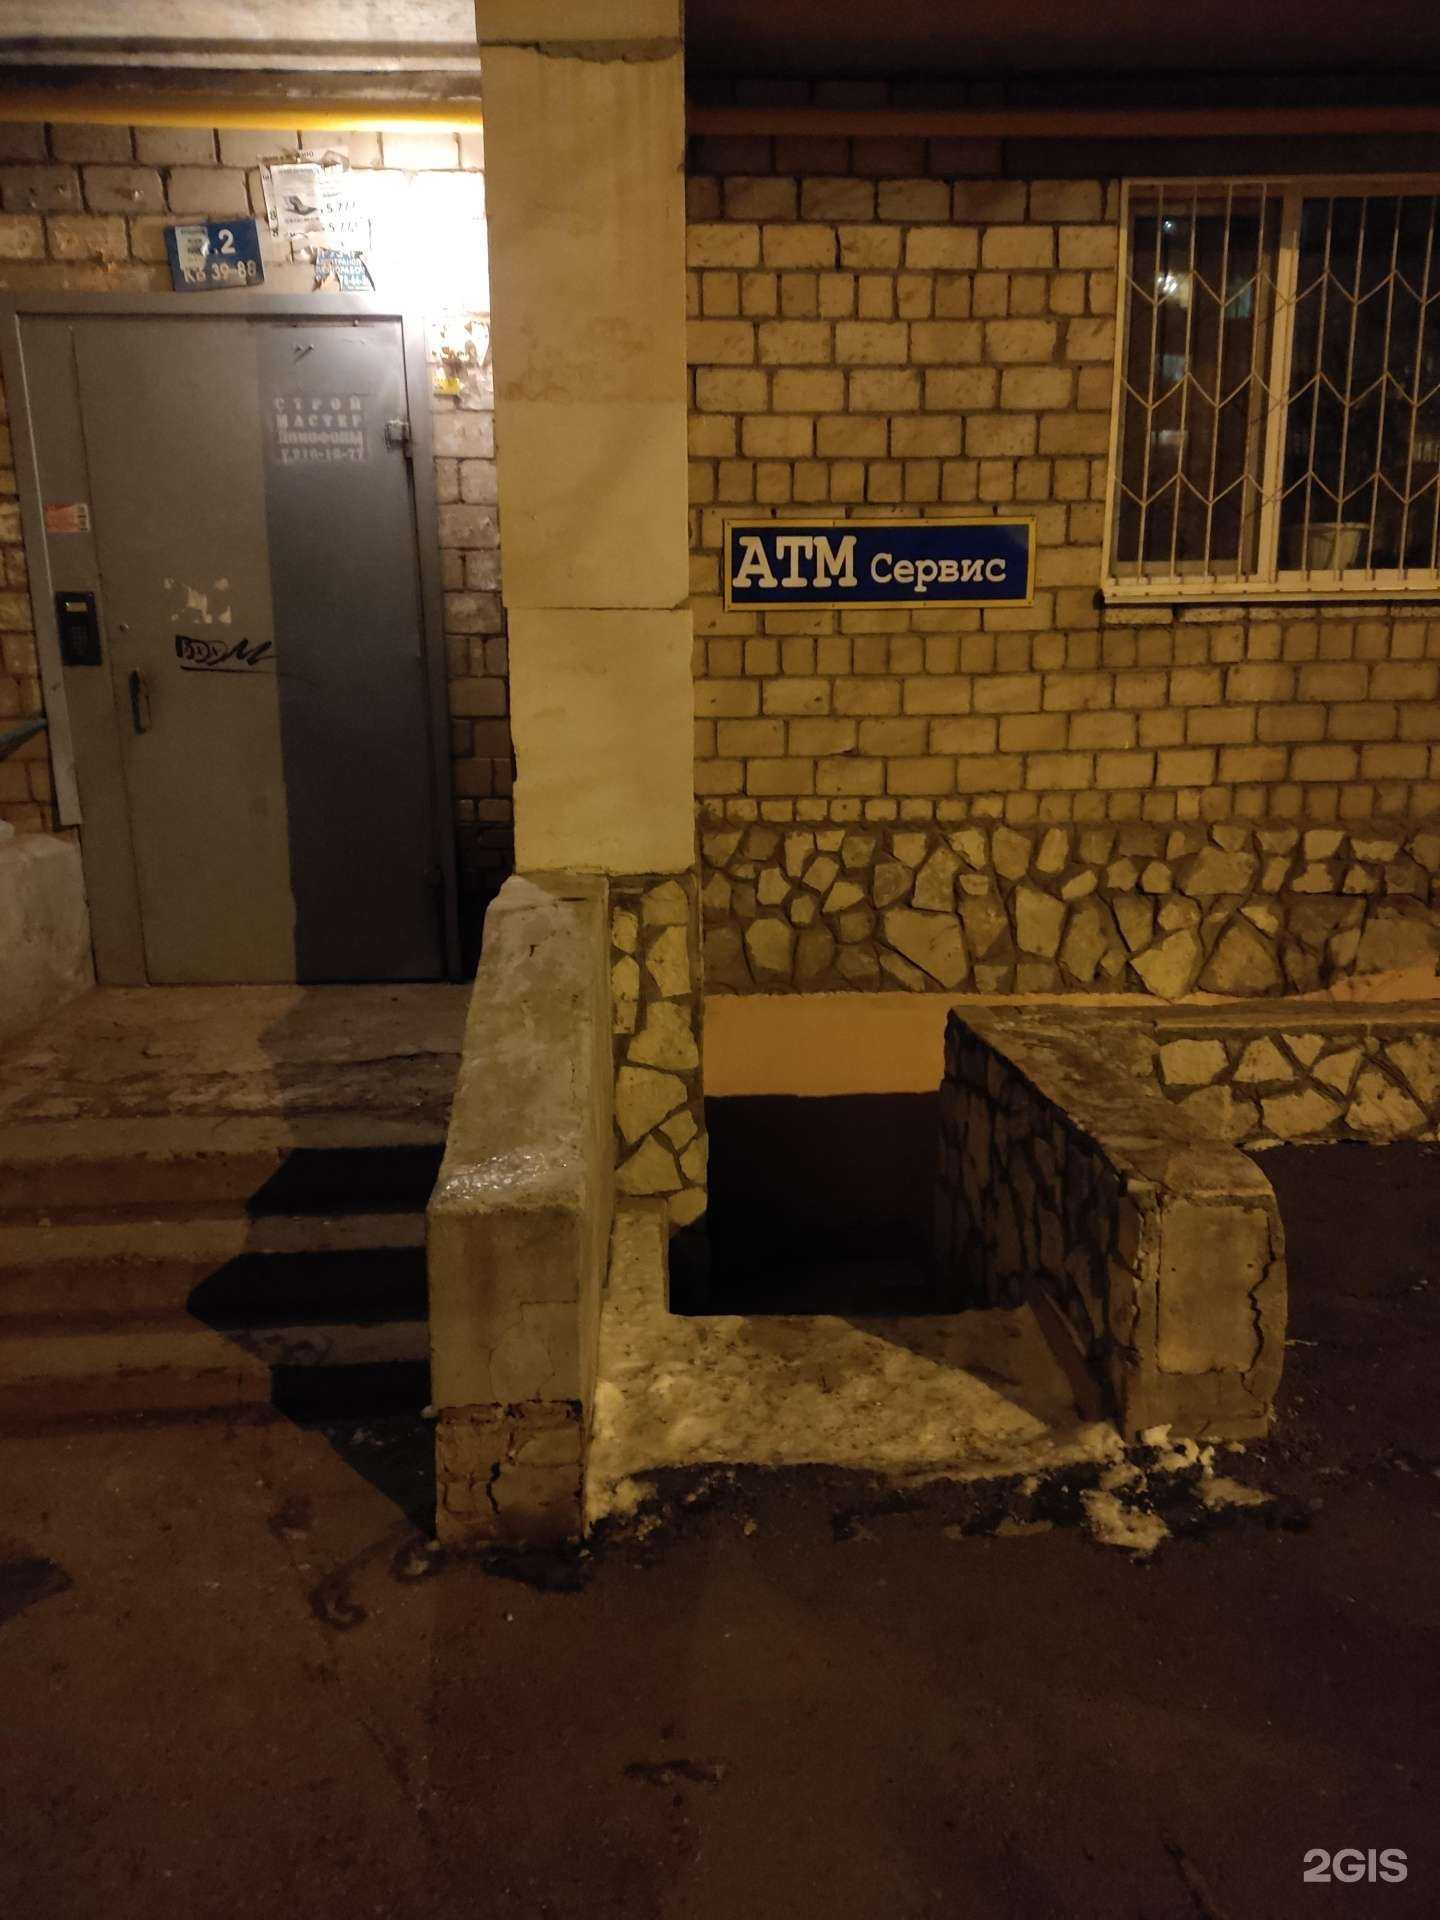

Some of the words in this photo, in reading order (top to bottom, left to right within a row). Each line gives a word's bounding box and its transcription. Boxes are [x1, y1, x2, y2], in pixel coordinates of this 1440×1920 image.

[218, 229, 237, 254] 2
[732, 535, 858, 588] АТМ
[870, 552, 1007, 593] Сервис
